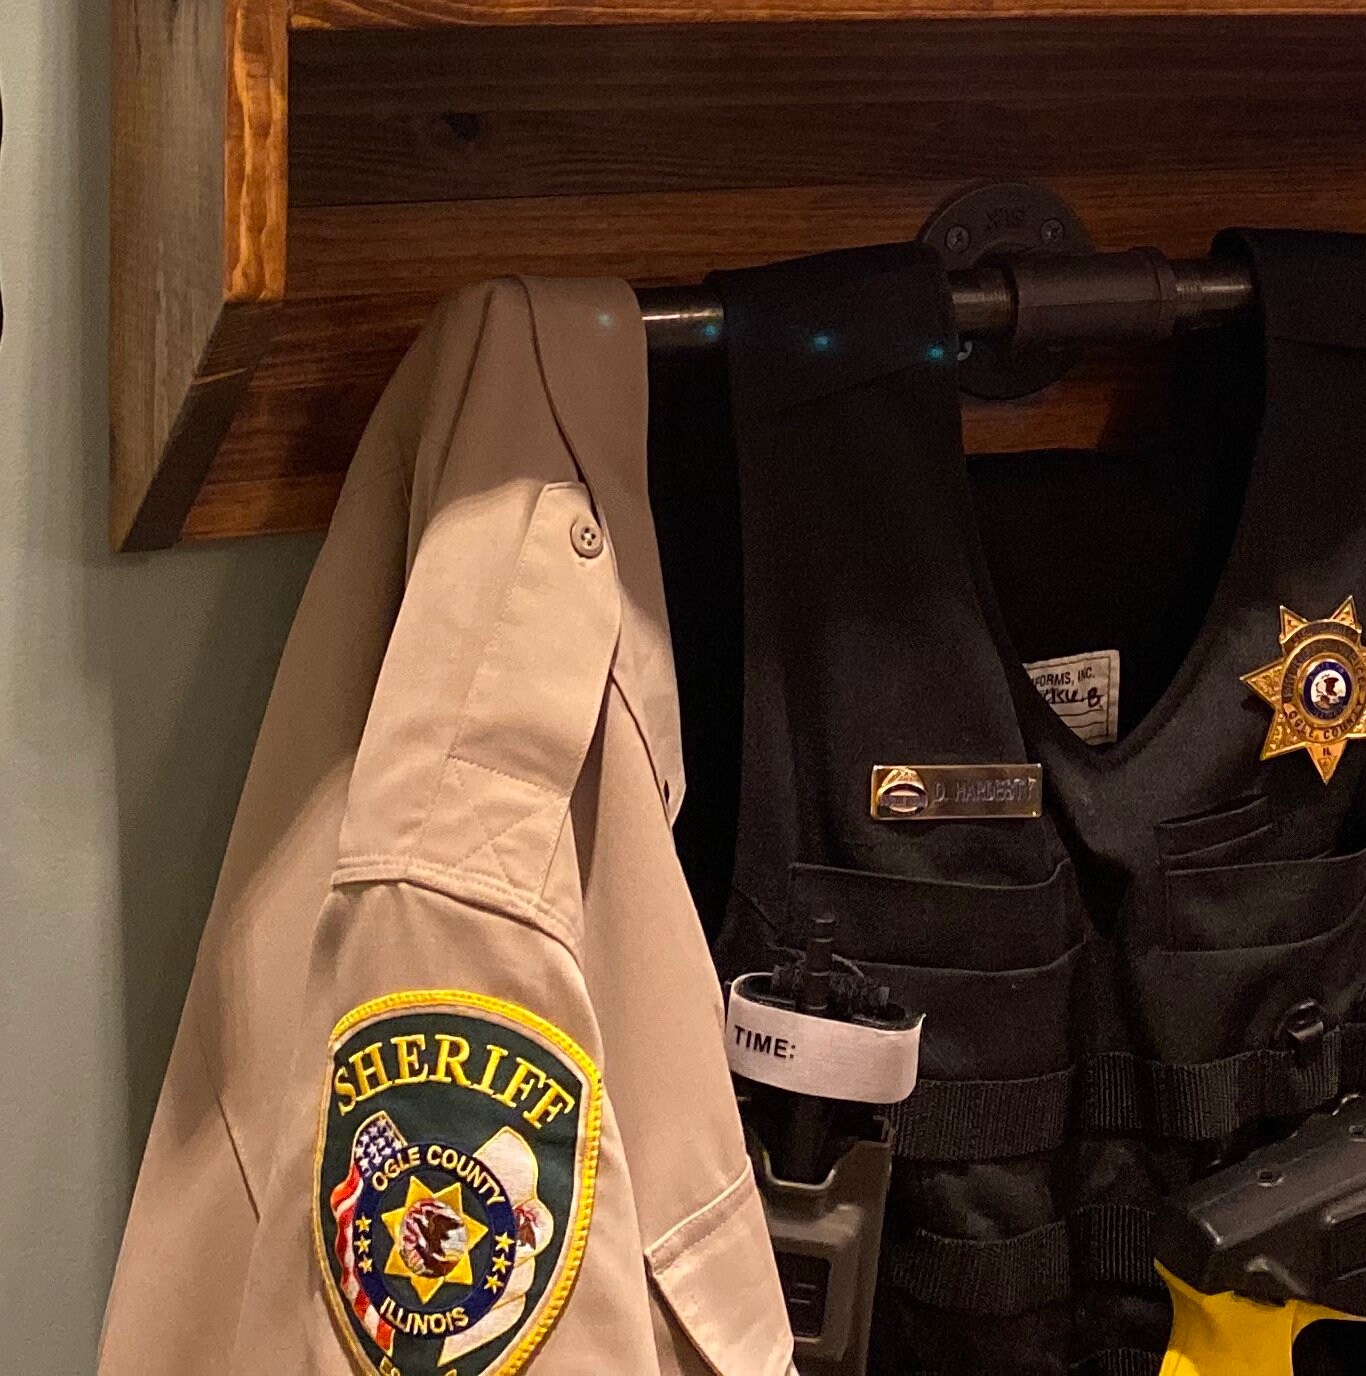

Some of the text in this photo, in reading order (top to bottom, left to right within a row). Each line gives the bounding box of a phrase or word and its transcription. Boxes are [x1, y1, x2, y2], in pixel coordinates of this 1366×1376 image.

[1077, 666, 1095, 683] INC.
[1322, 746, 1331, 756] IL
[733, 1024, 797, 1059] TIME:
[333, 1033, 576, 1130] SHERIFF
[372, 1144, 506, 1206] OGLE COUNTY
[380, 1296, 469, 1335] ILLINOIS
